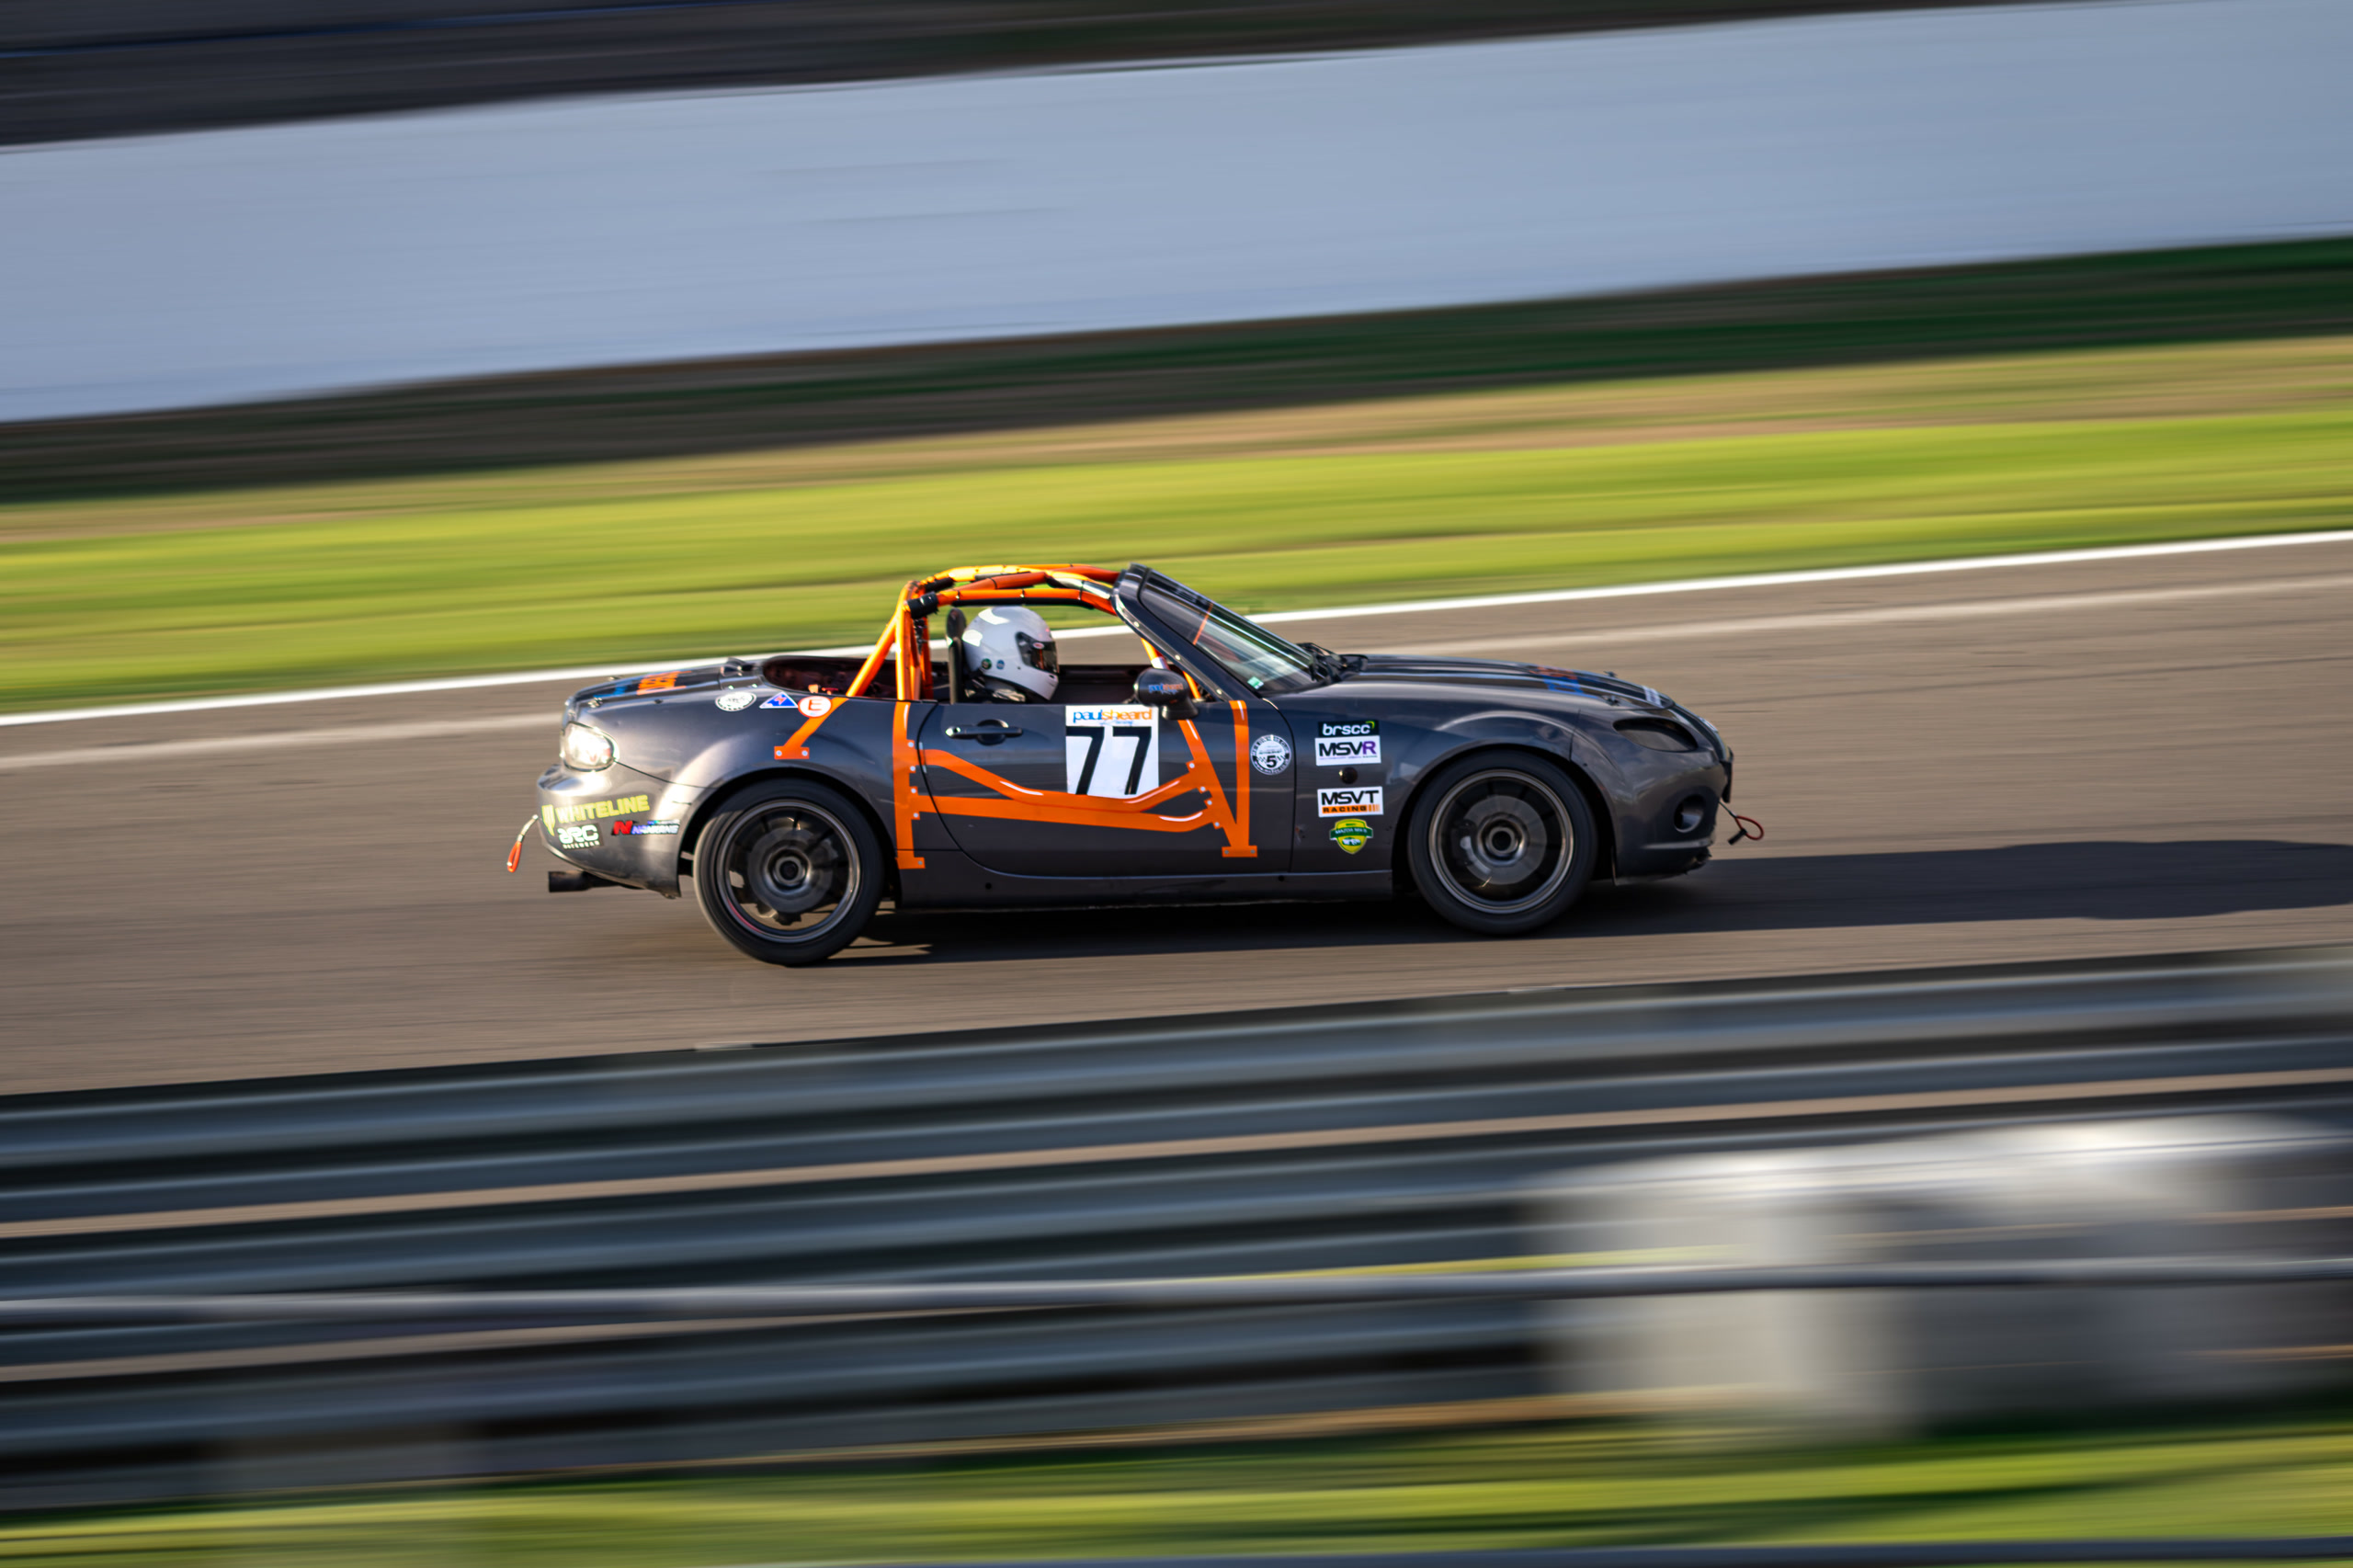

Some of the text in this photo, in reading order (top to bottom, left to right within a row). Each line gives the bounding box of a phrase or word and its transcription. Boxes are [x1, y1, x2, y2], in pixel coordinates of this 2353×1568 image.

[808, 699, 822, 711] E
[1323, 722, 1370, 736] brscc
[1319, 741, 1377, 756] MSVR
[1066, 725, 1152, 796] 77
[1267, 756, 1278, 768] 5
[1321, 790, 1379, 805] MSVT
[555, 794, 650, 824] WHITELINE
[1323, 805, 1368, 813] RACING
